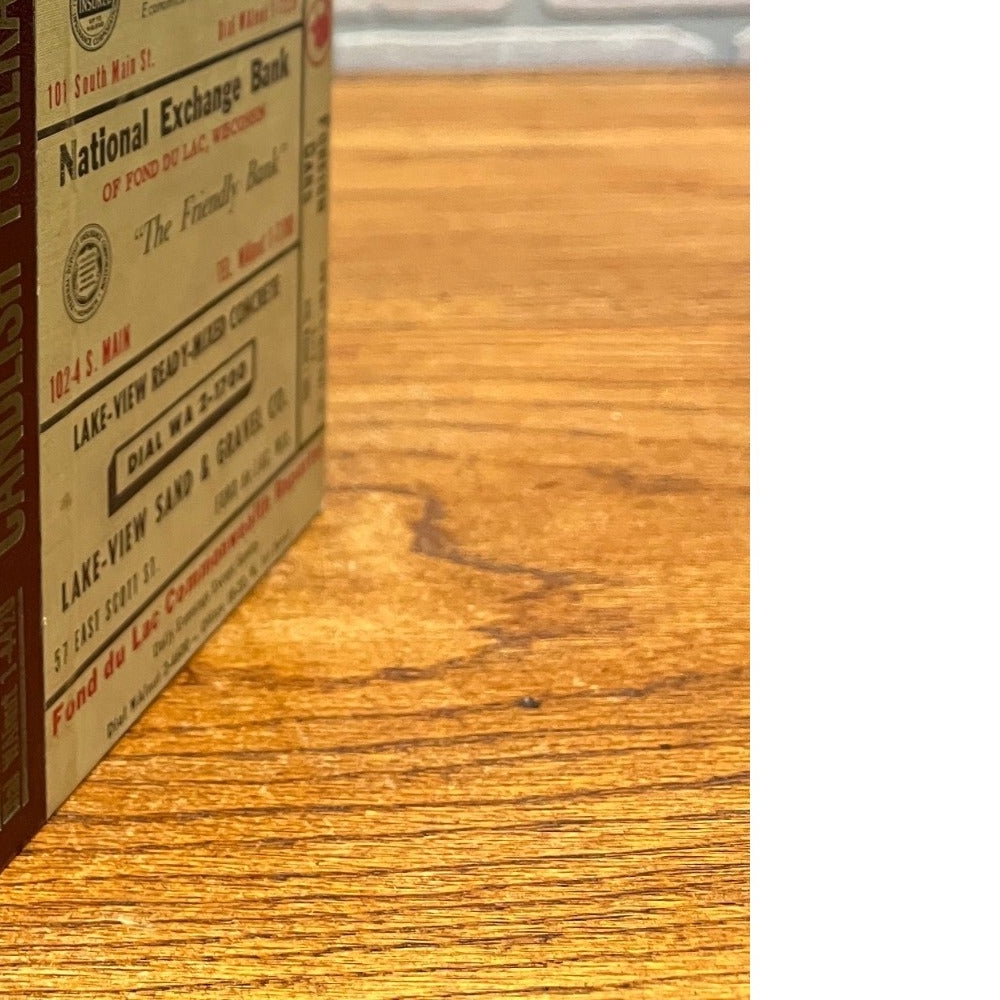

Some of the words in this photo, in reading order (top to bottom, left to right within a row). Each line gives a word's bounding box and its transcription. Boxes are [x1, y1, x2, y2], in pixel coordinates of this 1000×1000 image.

[48, 83, 67, 110] 101
[74, 67, 107, 99] South
[112, 55, 136, 84] Main
[141, 49, 155, 70] St.
[58, 108, 149, 188] National
[160, 76, 242, 138] Exchange
[251, 48, 291, 92] Bank
[102, 179, 119, 203] OF
[125, 158, 159, 193] FOND
[162, 147, 180, 173] DU
[180, 172, 239, 233] Friendly
[86, 349, 98, 377] S.
[102, 322, 131, 366] MAIN
[73, 373, 148, 451] LAKE-VIEW
[127, 431, 163, 475] DIAL
[168, 405, 193, 438] WA
[61, 507, 148, 613] LAKE-VIEW
[155, 468, 194, 524] SAND
[53, 641, 68, 673] 57
[74, 609, 100, 652] EAST
[105, 573, 139, 622] SCOTT
[53, 666, 98, 737] Fond
[103, 645, 126, 680] du
[131, 610, 161, 651] Lac
